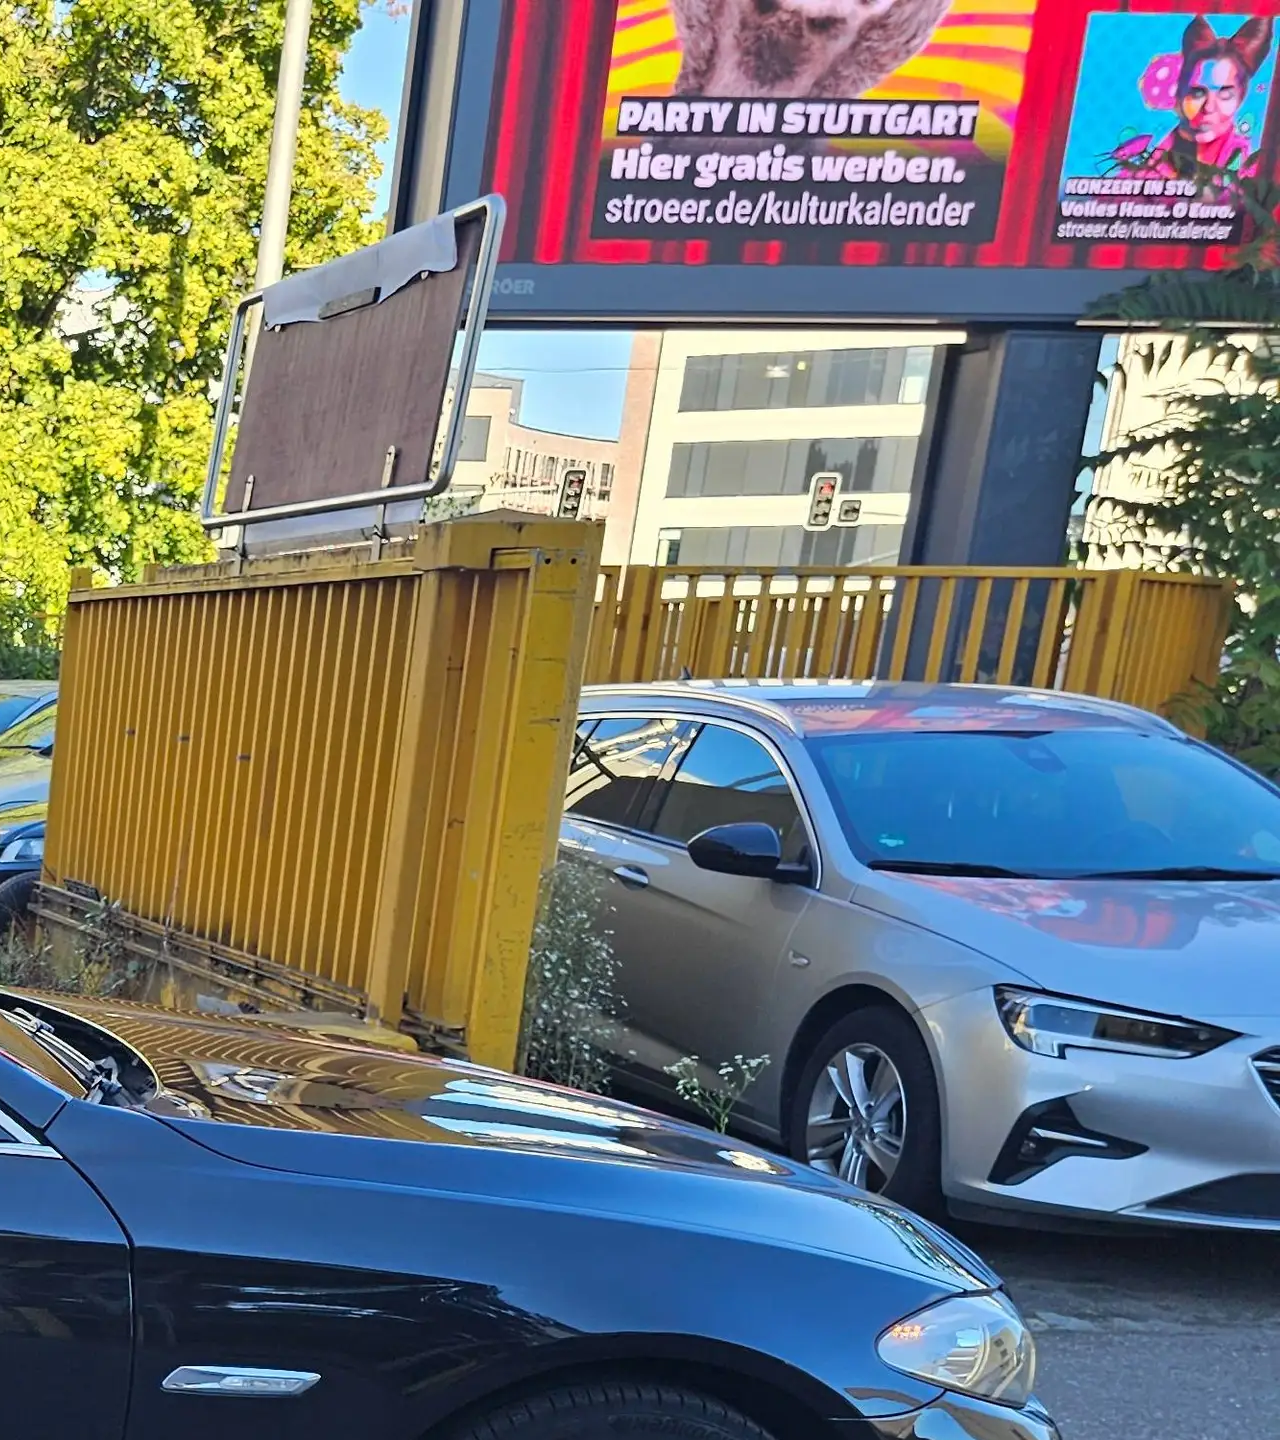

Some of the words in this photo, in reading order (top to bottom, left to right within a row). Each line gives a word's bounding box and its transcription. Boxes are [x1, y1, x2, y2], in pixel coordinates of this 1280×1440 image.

[618, 101, 733, 133] PARTY
[737, 102, 777, 133] IN
[781, 103, 979, 136] STUTTGART
[611, 143, 691, 180] Hier
[694, 144, 806, 187] gratis
[811, 149, 966, 184] werben.
[1065, 178, 1143, 196] KONZERT
[1143, 180, 1165, 196] IN
[604, 190, 975, 228] stroeer.de/kulturkalender
[1060, 201, 1118, 219] Volles
[1119, 202, 1171, 219] Haus.
[1188, 204, 1236, 220] Euro.
[1056, 221, 1233, 240] stroeer.de/kulturkalender
